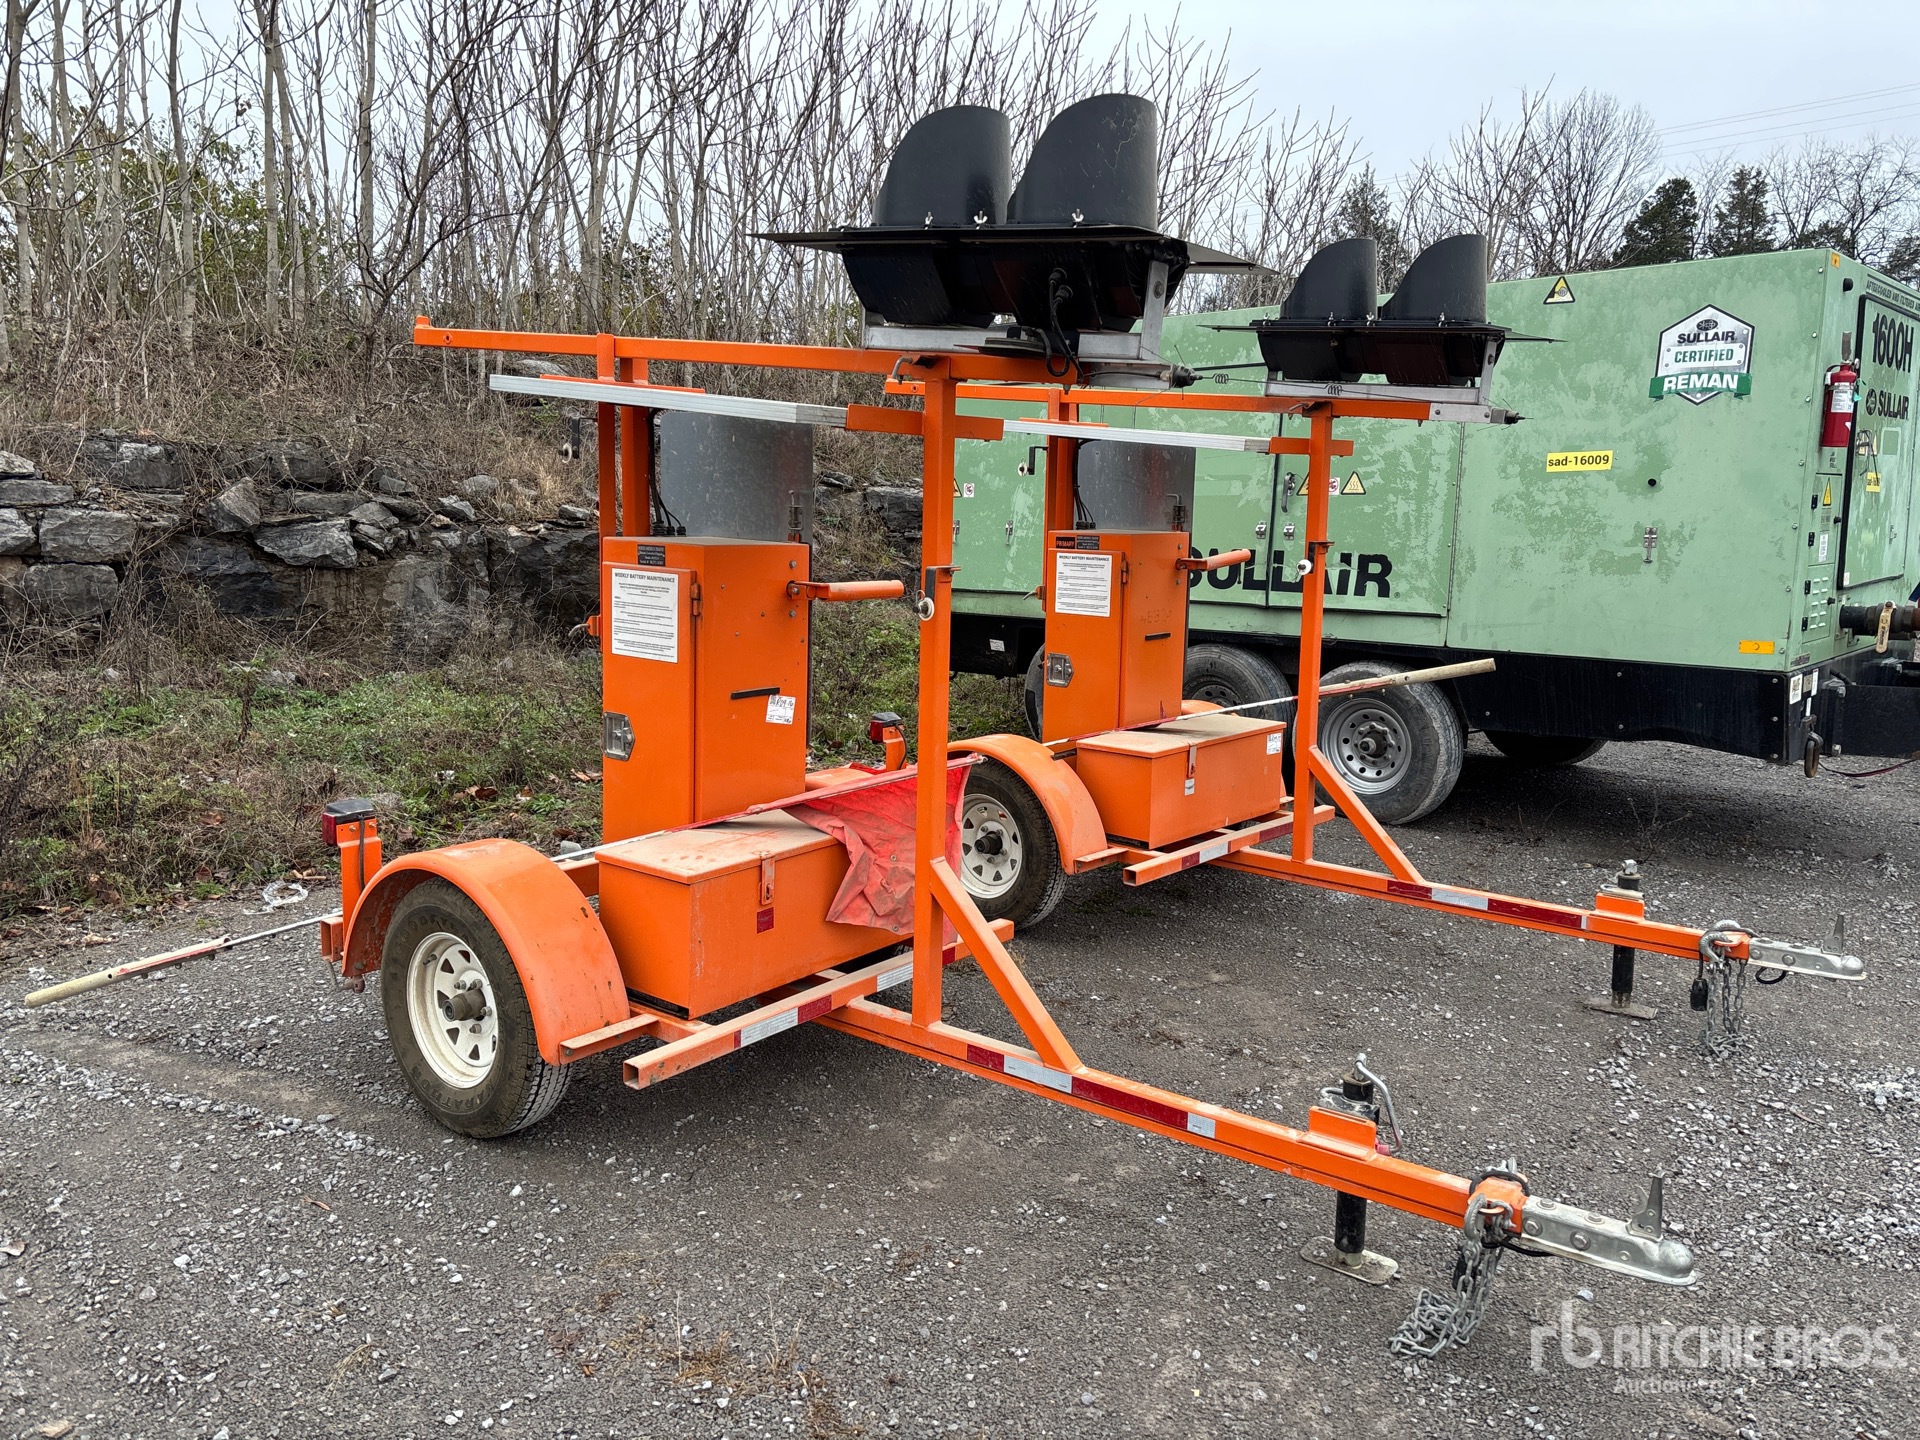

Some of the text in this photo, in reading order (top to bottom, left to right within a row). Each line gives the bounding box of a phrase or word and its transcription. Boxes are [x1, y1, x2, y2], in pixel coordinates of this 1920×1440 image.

[1677, 330, 1736, 344] SULLAIR
[1872, 312, 1915, 374] 1600H
[1674, 348, 1734, 363] CERTIFIED
[1663, 373, 1739, 392] REMAN
[1878, 389, 1910, 420] SULLAIR
[1548, 454, 1610, 467] sad-16009
[1056, 540, 1075, 548] PRIMARY
